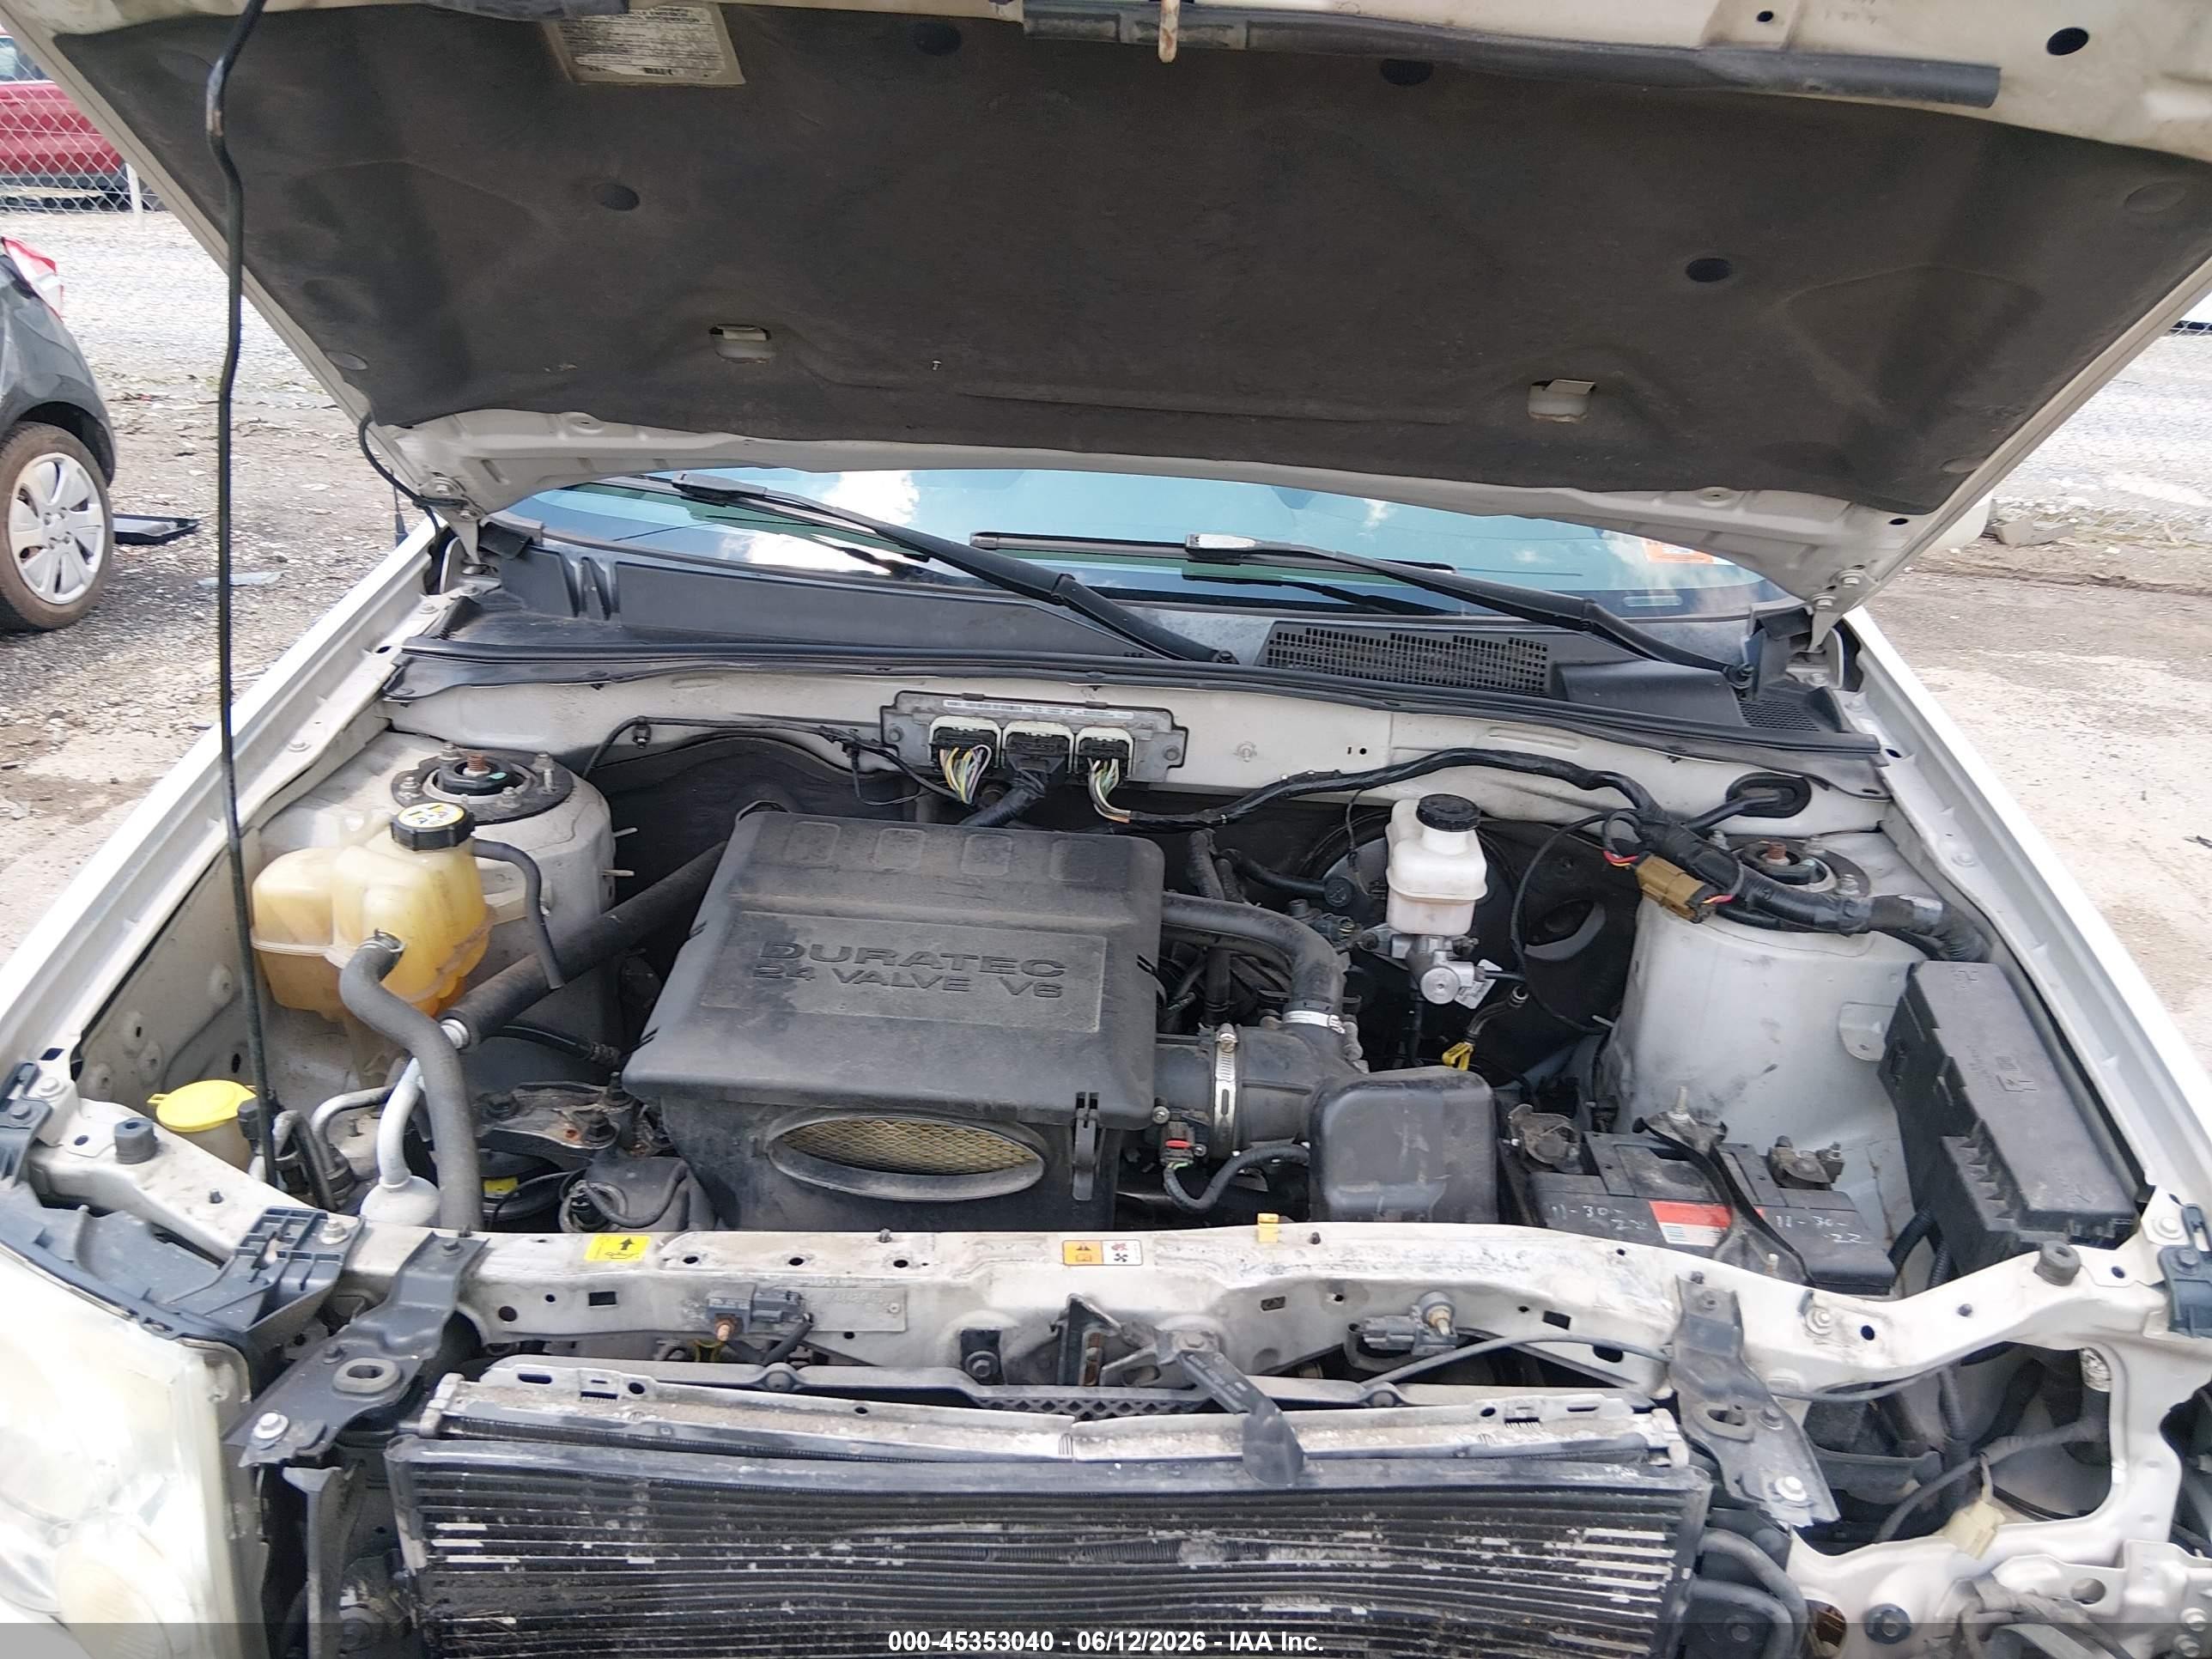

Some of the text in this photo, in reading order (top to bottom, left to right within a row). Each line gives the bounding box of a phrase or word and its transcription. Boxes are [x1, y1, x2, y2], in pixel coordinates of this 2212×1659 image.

[759, 941, 1066, 978] DURATEC
[753, 963, 1064, 999] 24 VALVE V6
